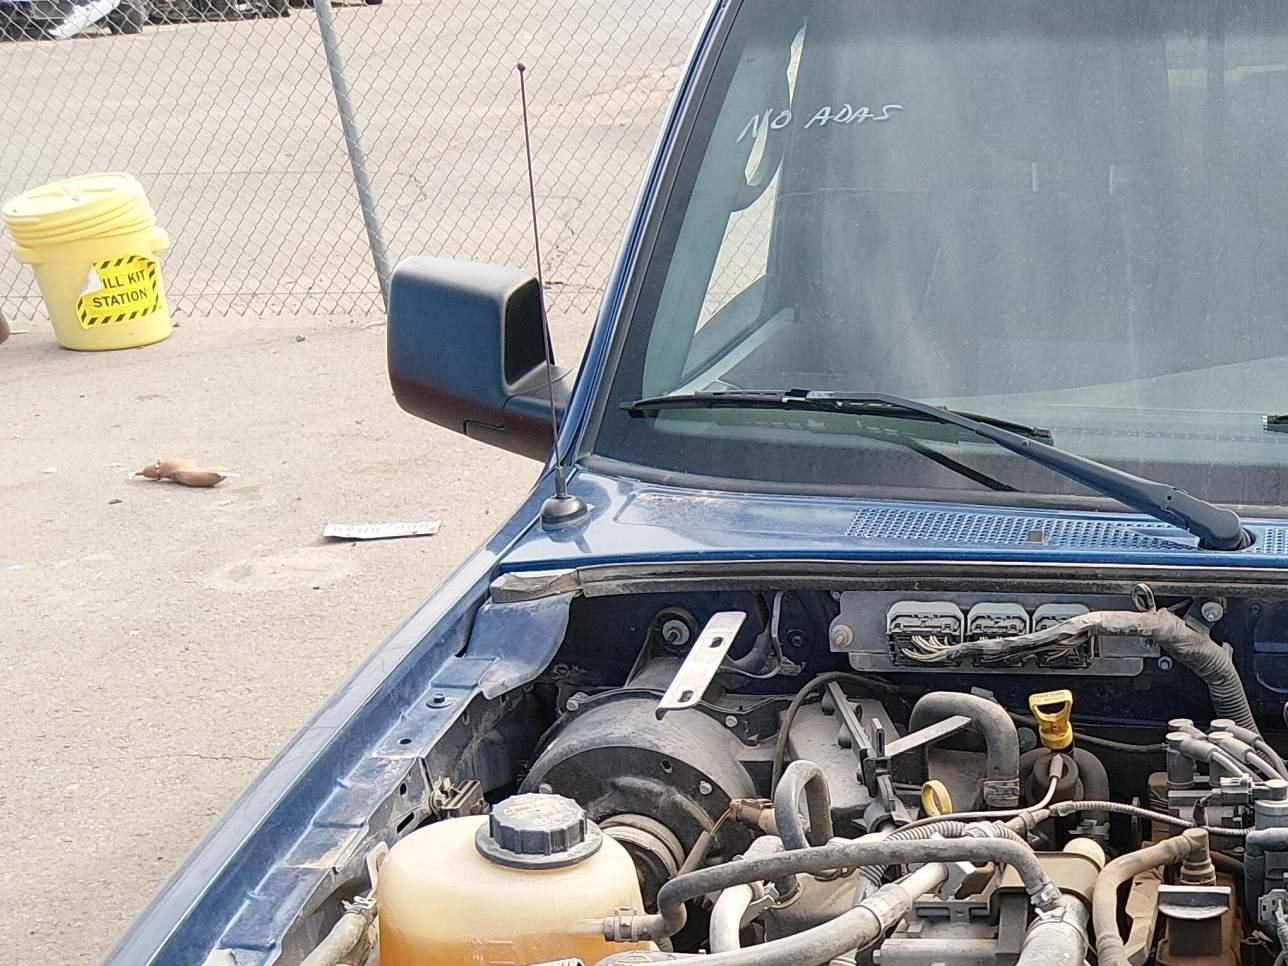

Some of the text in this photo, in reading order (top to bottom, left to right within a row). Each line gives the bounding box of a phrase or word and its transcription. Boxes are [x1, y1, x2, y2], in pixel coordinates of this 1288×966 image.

[736, 103, 903, 144] NO ADAS
[127, 269, 146, 285] KIT
[92, 287, 148, 308] STATION
